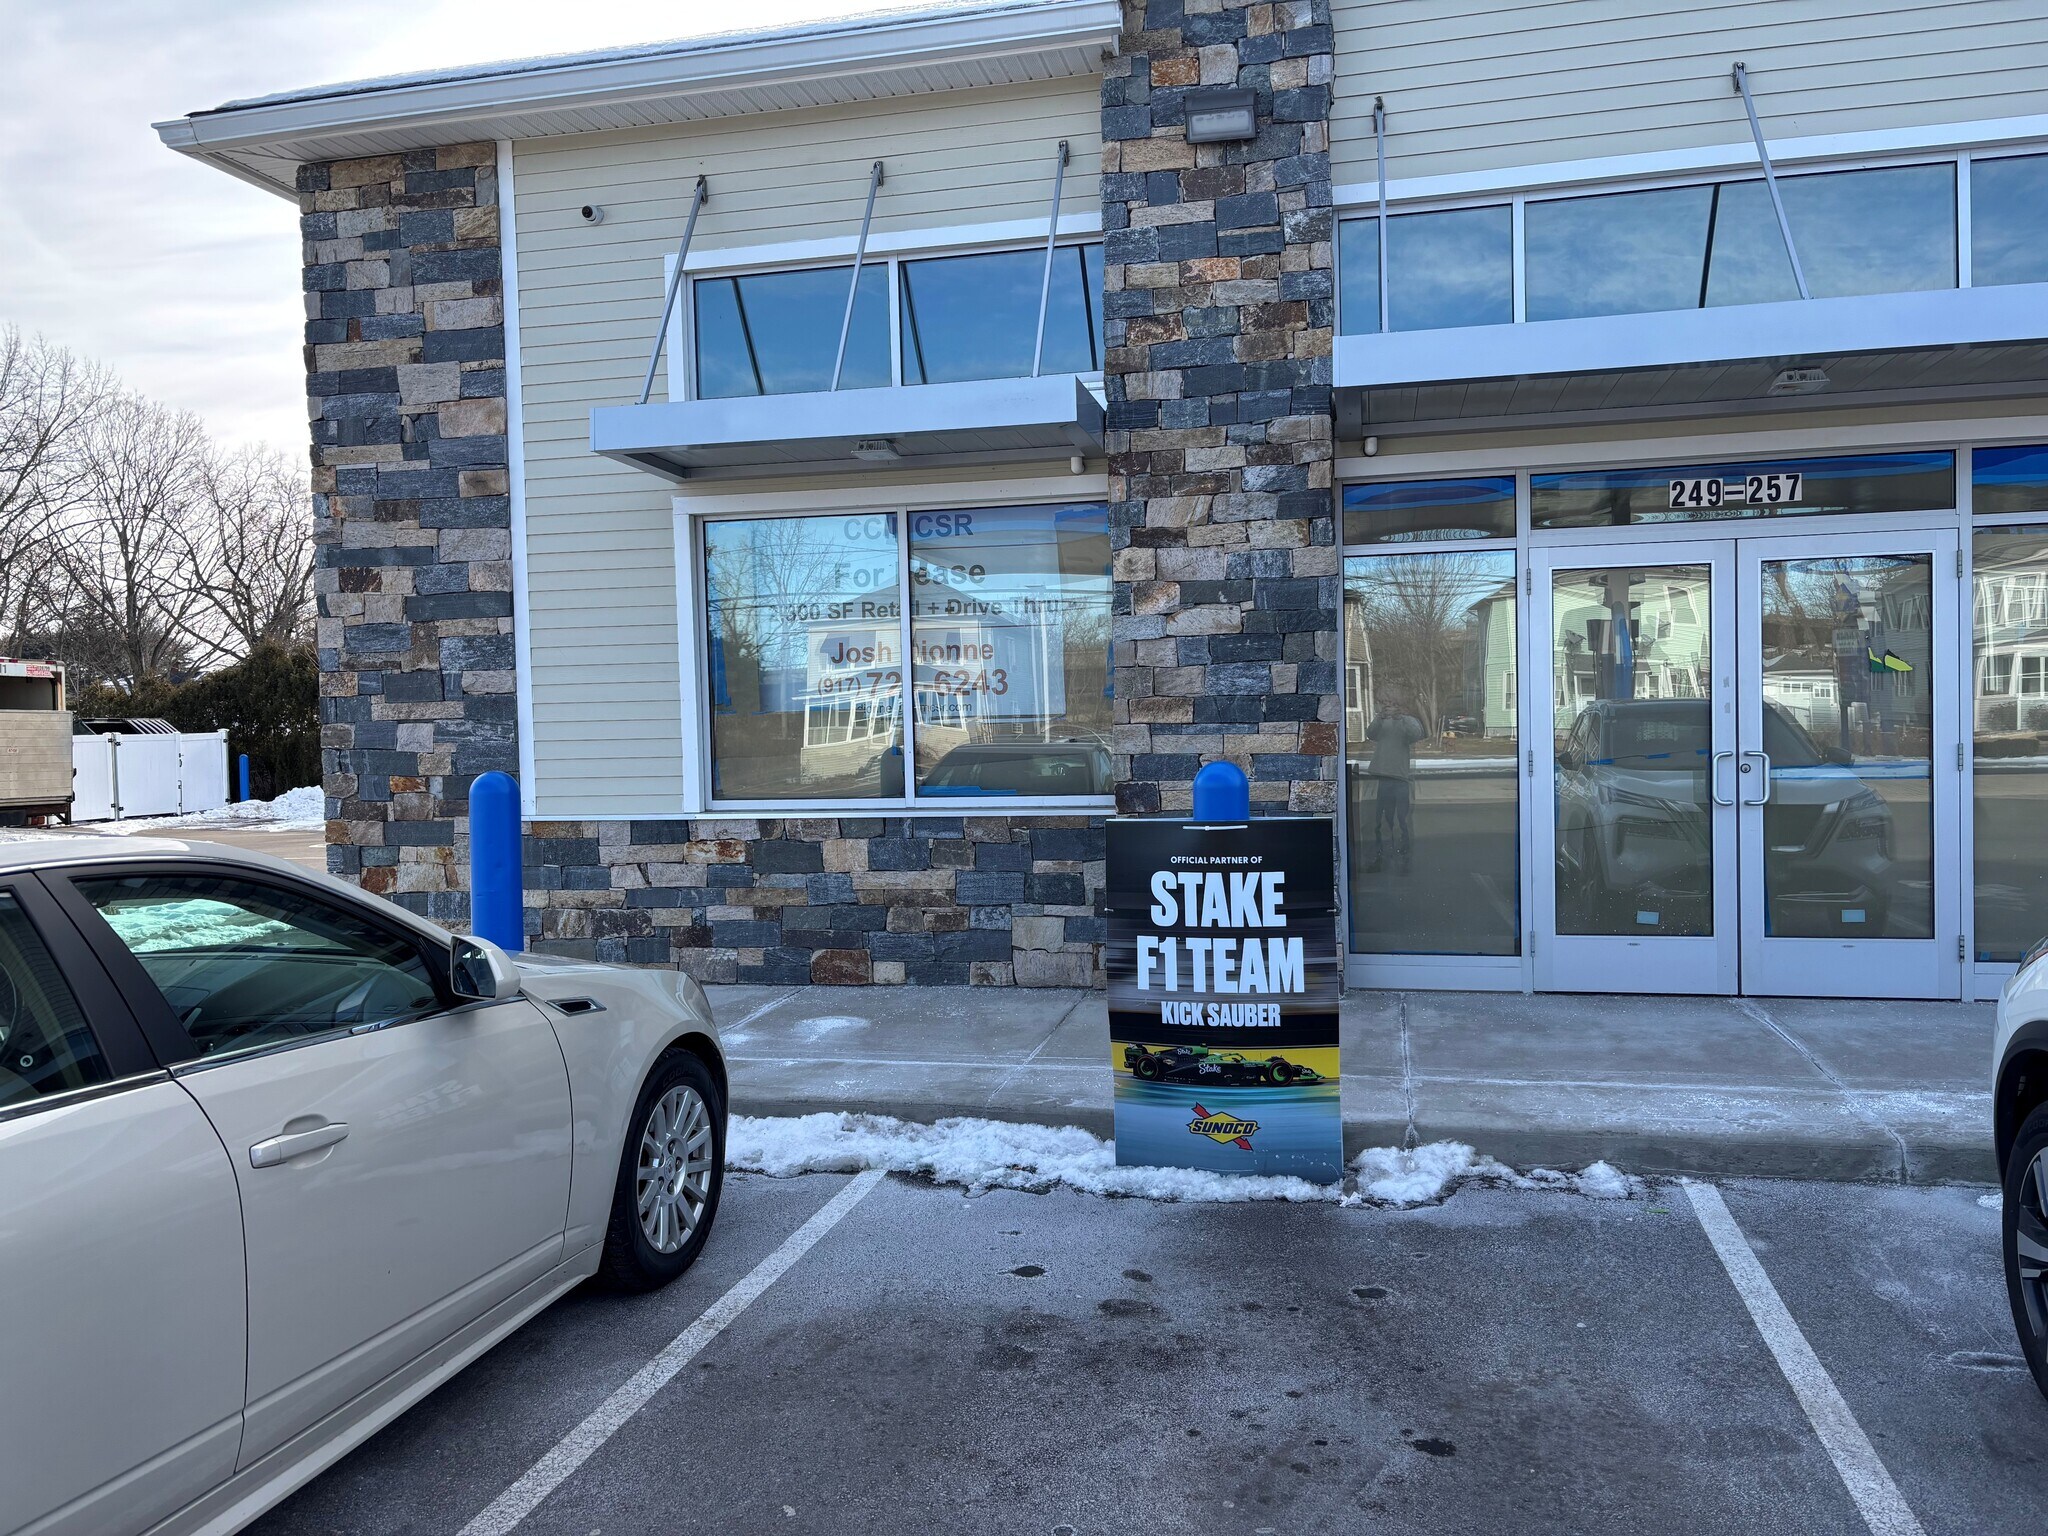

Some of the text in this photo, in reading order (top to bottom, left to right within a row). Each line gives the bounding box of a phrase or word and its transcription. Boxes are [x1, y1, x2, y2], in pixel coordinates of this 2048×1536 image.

[1671, 474, 1800, 507] 249-257
[834, 563, 885, 588] For
[827, 601, 854, 619] SF
[948, 598, 1003, 616] Drive
[830, 641, 892, 664] Josh
[818, 676, 862, 697] (917)
[1170, 855, 1263, 865] OFFICIAL PARTNER OF
[1150, 870, 1287, 928] STAKE
[1136, 935, 1305, 994] F1 TEAM
[1160, 1001, 1281, 1027] KICK SAUBER
[1198, 1063, 1222, 1075] Stake
[1192, 1120, 1256, 1135] SUNOCO
